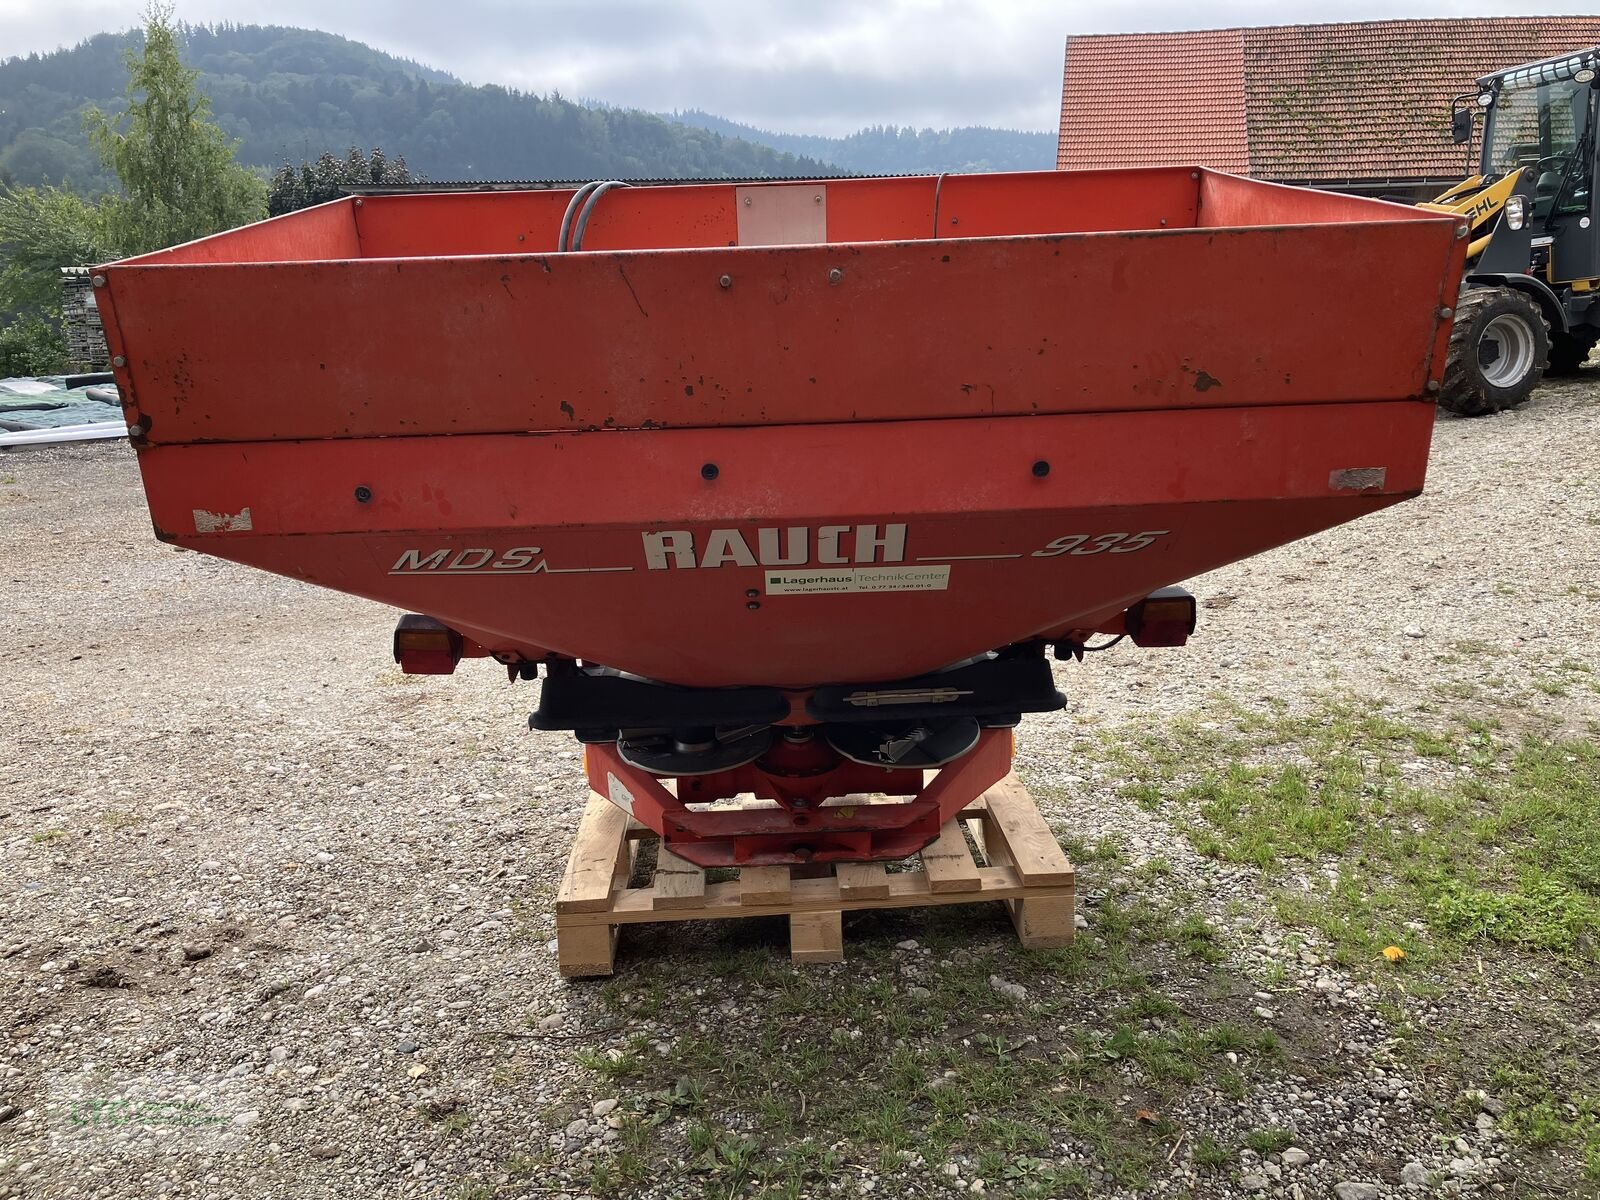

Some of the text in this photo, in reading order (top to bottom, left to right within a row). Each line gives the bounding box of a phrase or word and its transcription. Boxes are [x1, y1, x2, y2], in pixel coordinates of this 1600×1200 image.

[391, 523, 1171, 570] MDS RAUCH 935
[783, 572, 947, 584] Lagerhaus TechnikCenter
